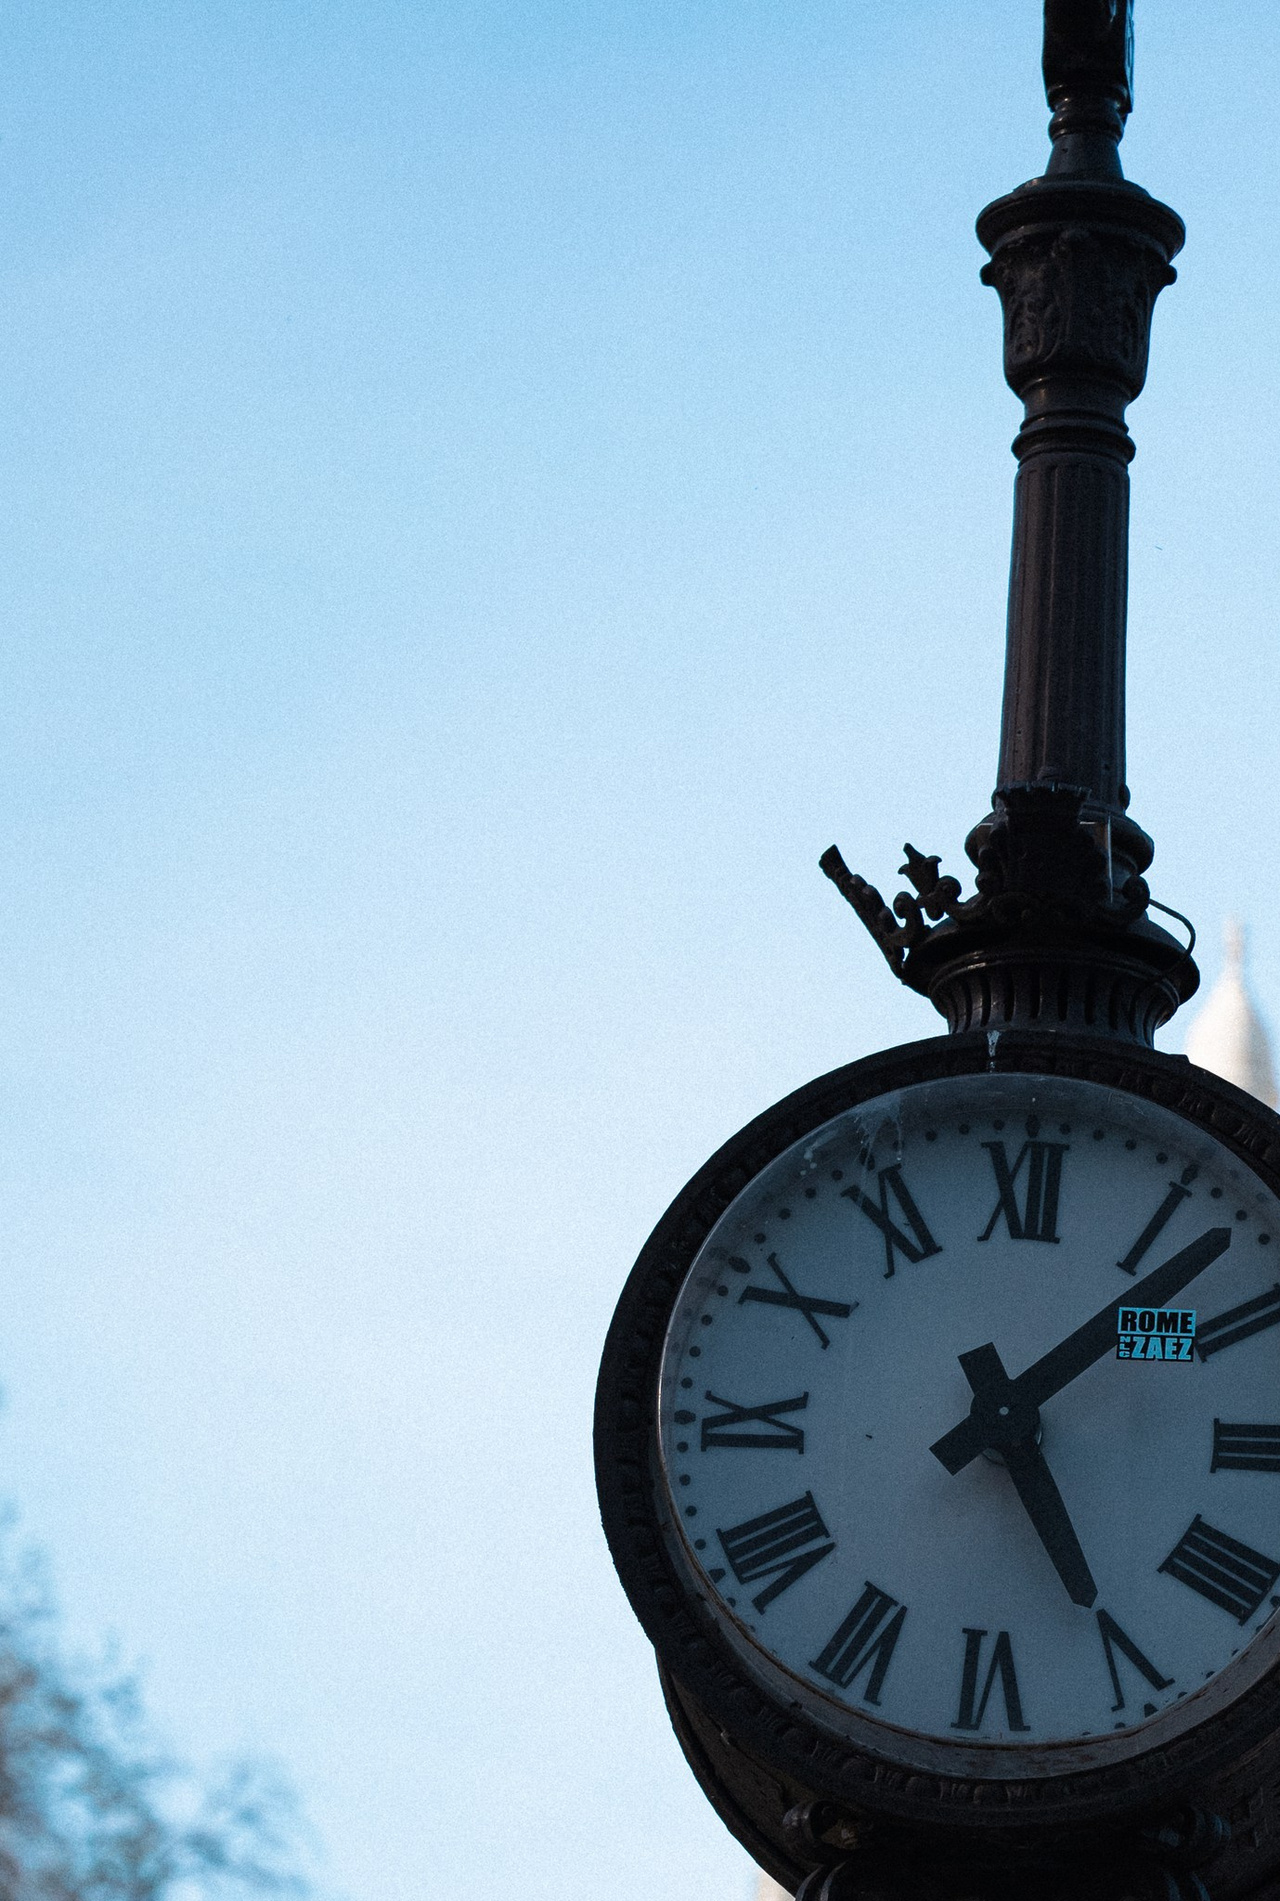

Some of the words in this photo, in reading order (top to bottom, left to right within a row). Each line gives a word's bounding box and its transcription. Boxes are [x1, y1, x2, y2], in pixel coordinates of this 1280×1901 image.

[840, 1163, 942, 1280] XI
[977, 1141, 1070, 1244] XII
[1116, 1181, 1193, 1276] I
[737, 1252, 860, 1350] X
[1120, 1310, 1193, 1334] ROME
[1131, 1336, 1192, 1360] ZAEZ
[700, 1390, 810, 1455] IX
[715, 1490, 837, 1616] VIII
[808, 1580, 909, 1707] VII
[950, 1627, 1032, 1732] VI
[1096, 1608, 1176, 1712] V
